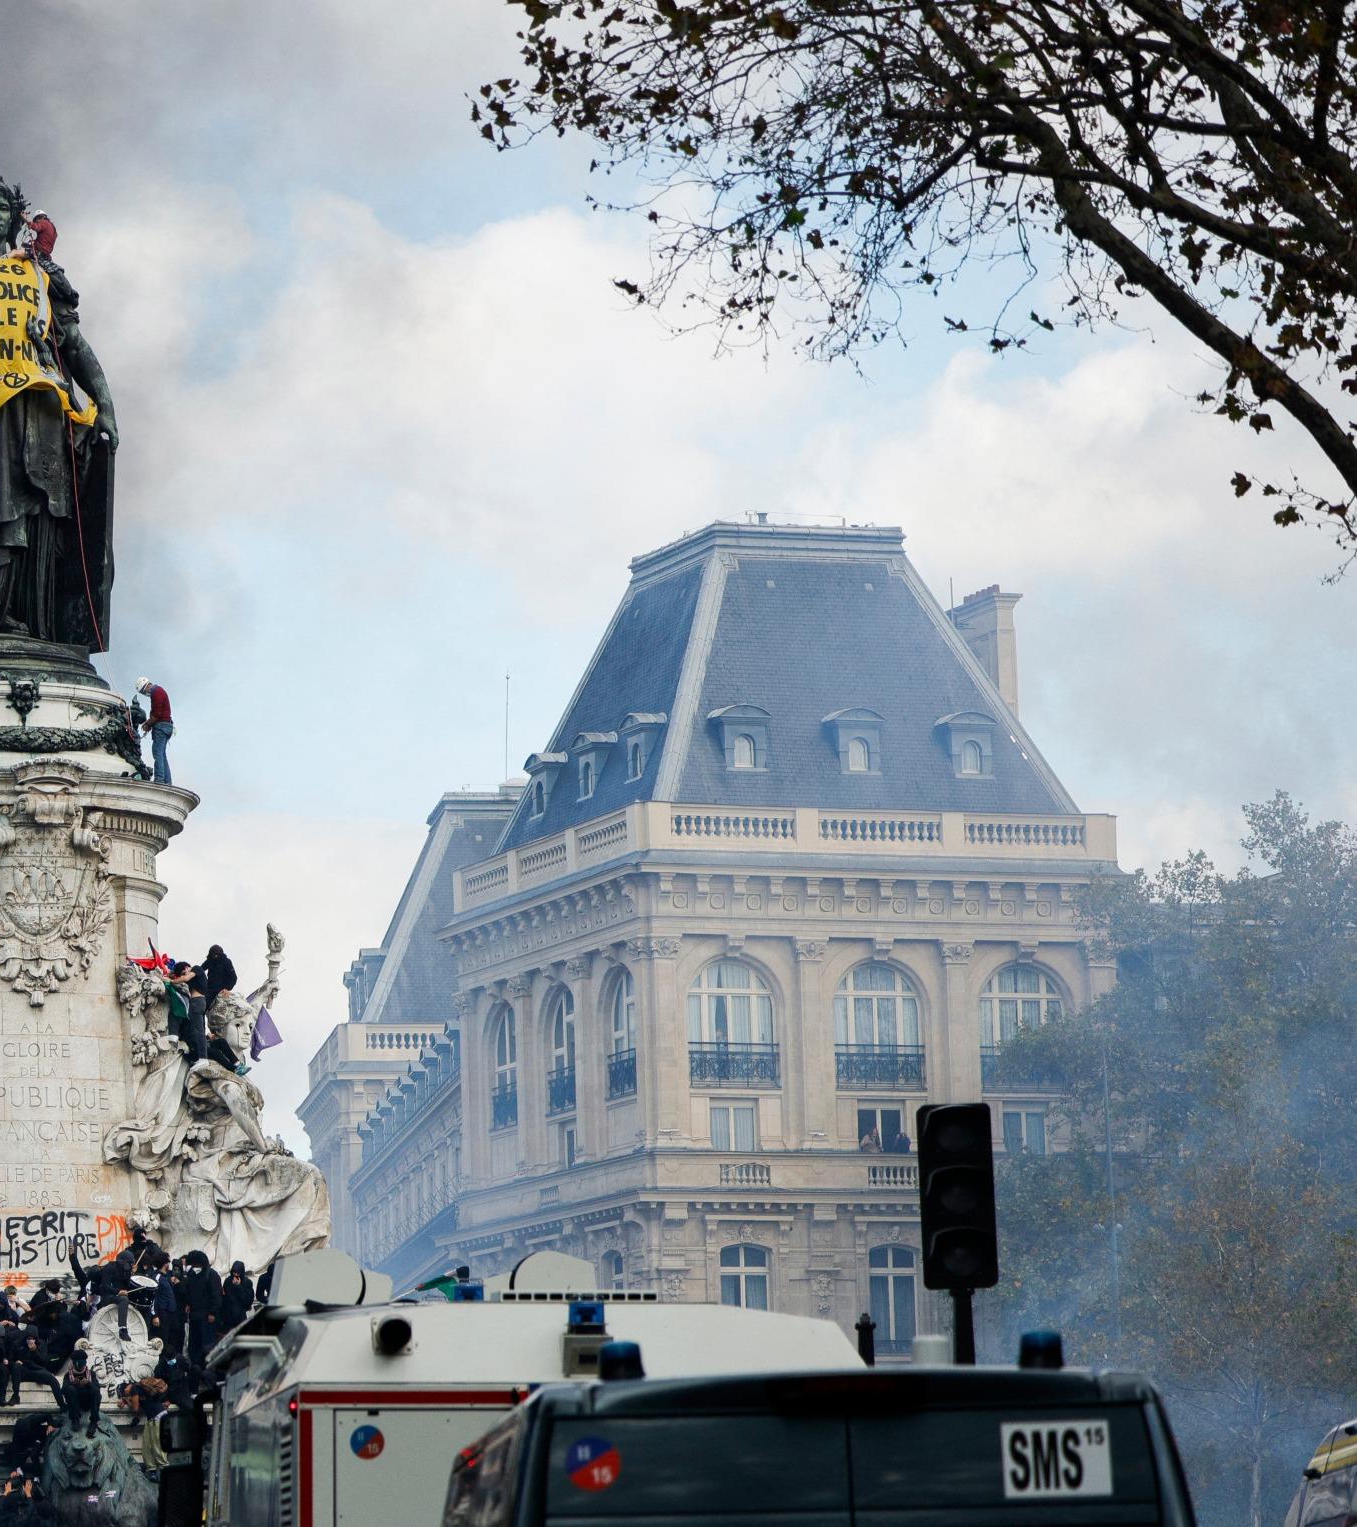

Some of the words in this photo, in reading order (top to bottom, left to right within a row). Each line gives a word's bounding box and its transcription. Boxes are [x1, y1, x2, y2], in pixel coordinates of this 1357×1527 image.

[20, 1022, 31, 1034] A
[36, 1021, 55, 1034] LA
[3, 1042, 71, 1058] GLOIRE
[20, 1066, 36, 1077] DE
[42, 1066, 57, 1078] LA
[32, 1149, 51, 1161] LA
[31, 1167, 52, 1183] DE
[58, 1168, 100, 1185] PARIS
[5, 1211, 89, 1240] ECRIT
[1009, 1428, 1084, 1492] SMS
